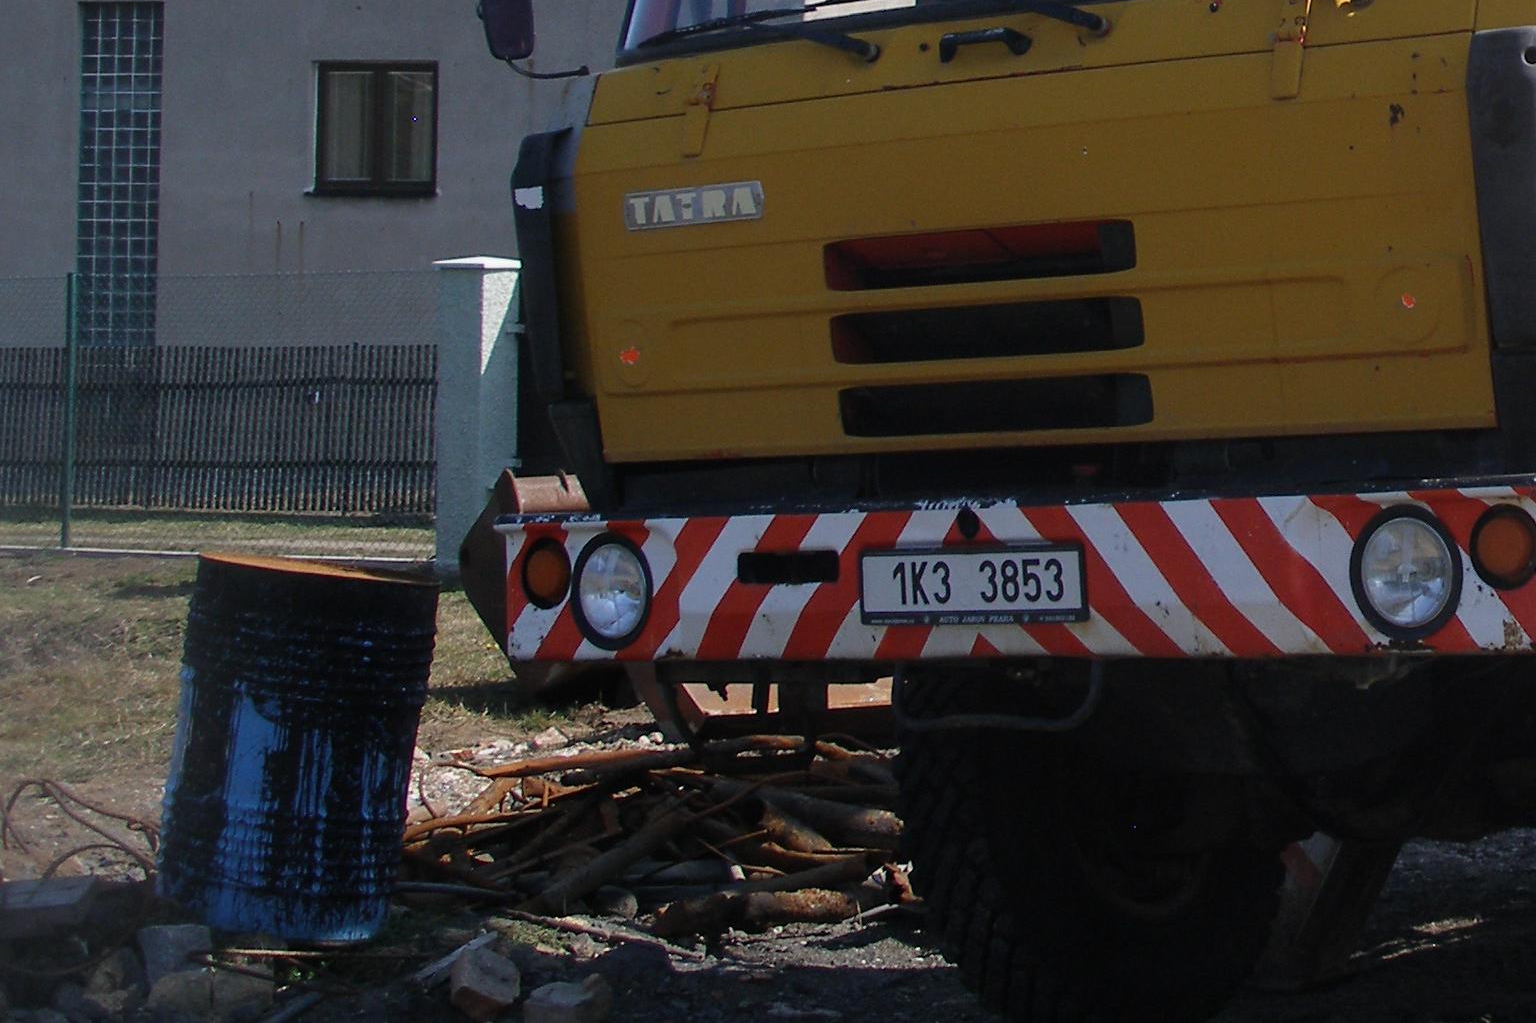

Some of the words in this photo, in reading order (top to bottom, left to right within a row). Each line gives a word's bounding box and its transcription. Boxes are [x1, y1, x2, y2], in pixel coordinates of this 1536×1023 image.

[628, 185, 757, 225] TATRA
[892, 560, 952, 606] 1K3
[978, 558, 1065, 603] 3853
